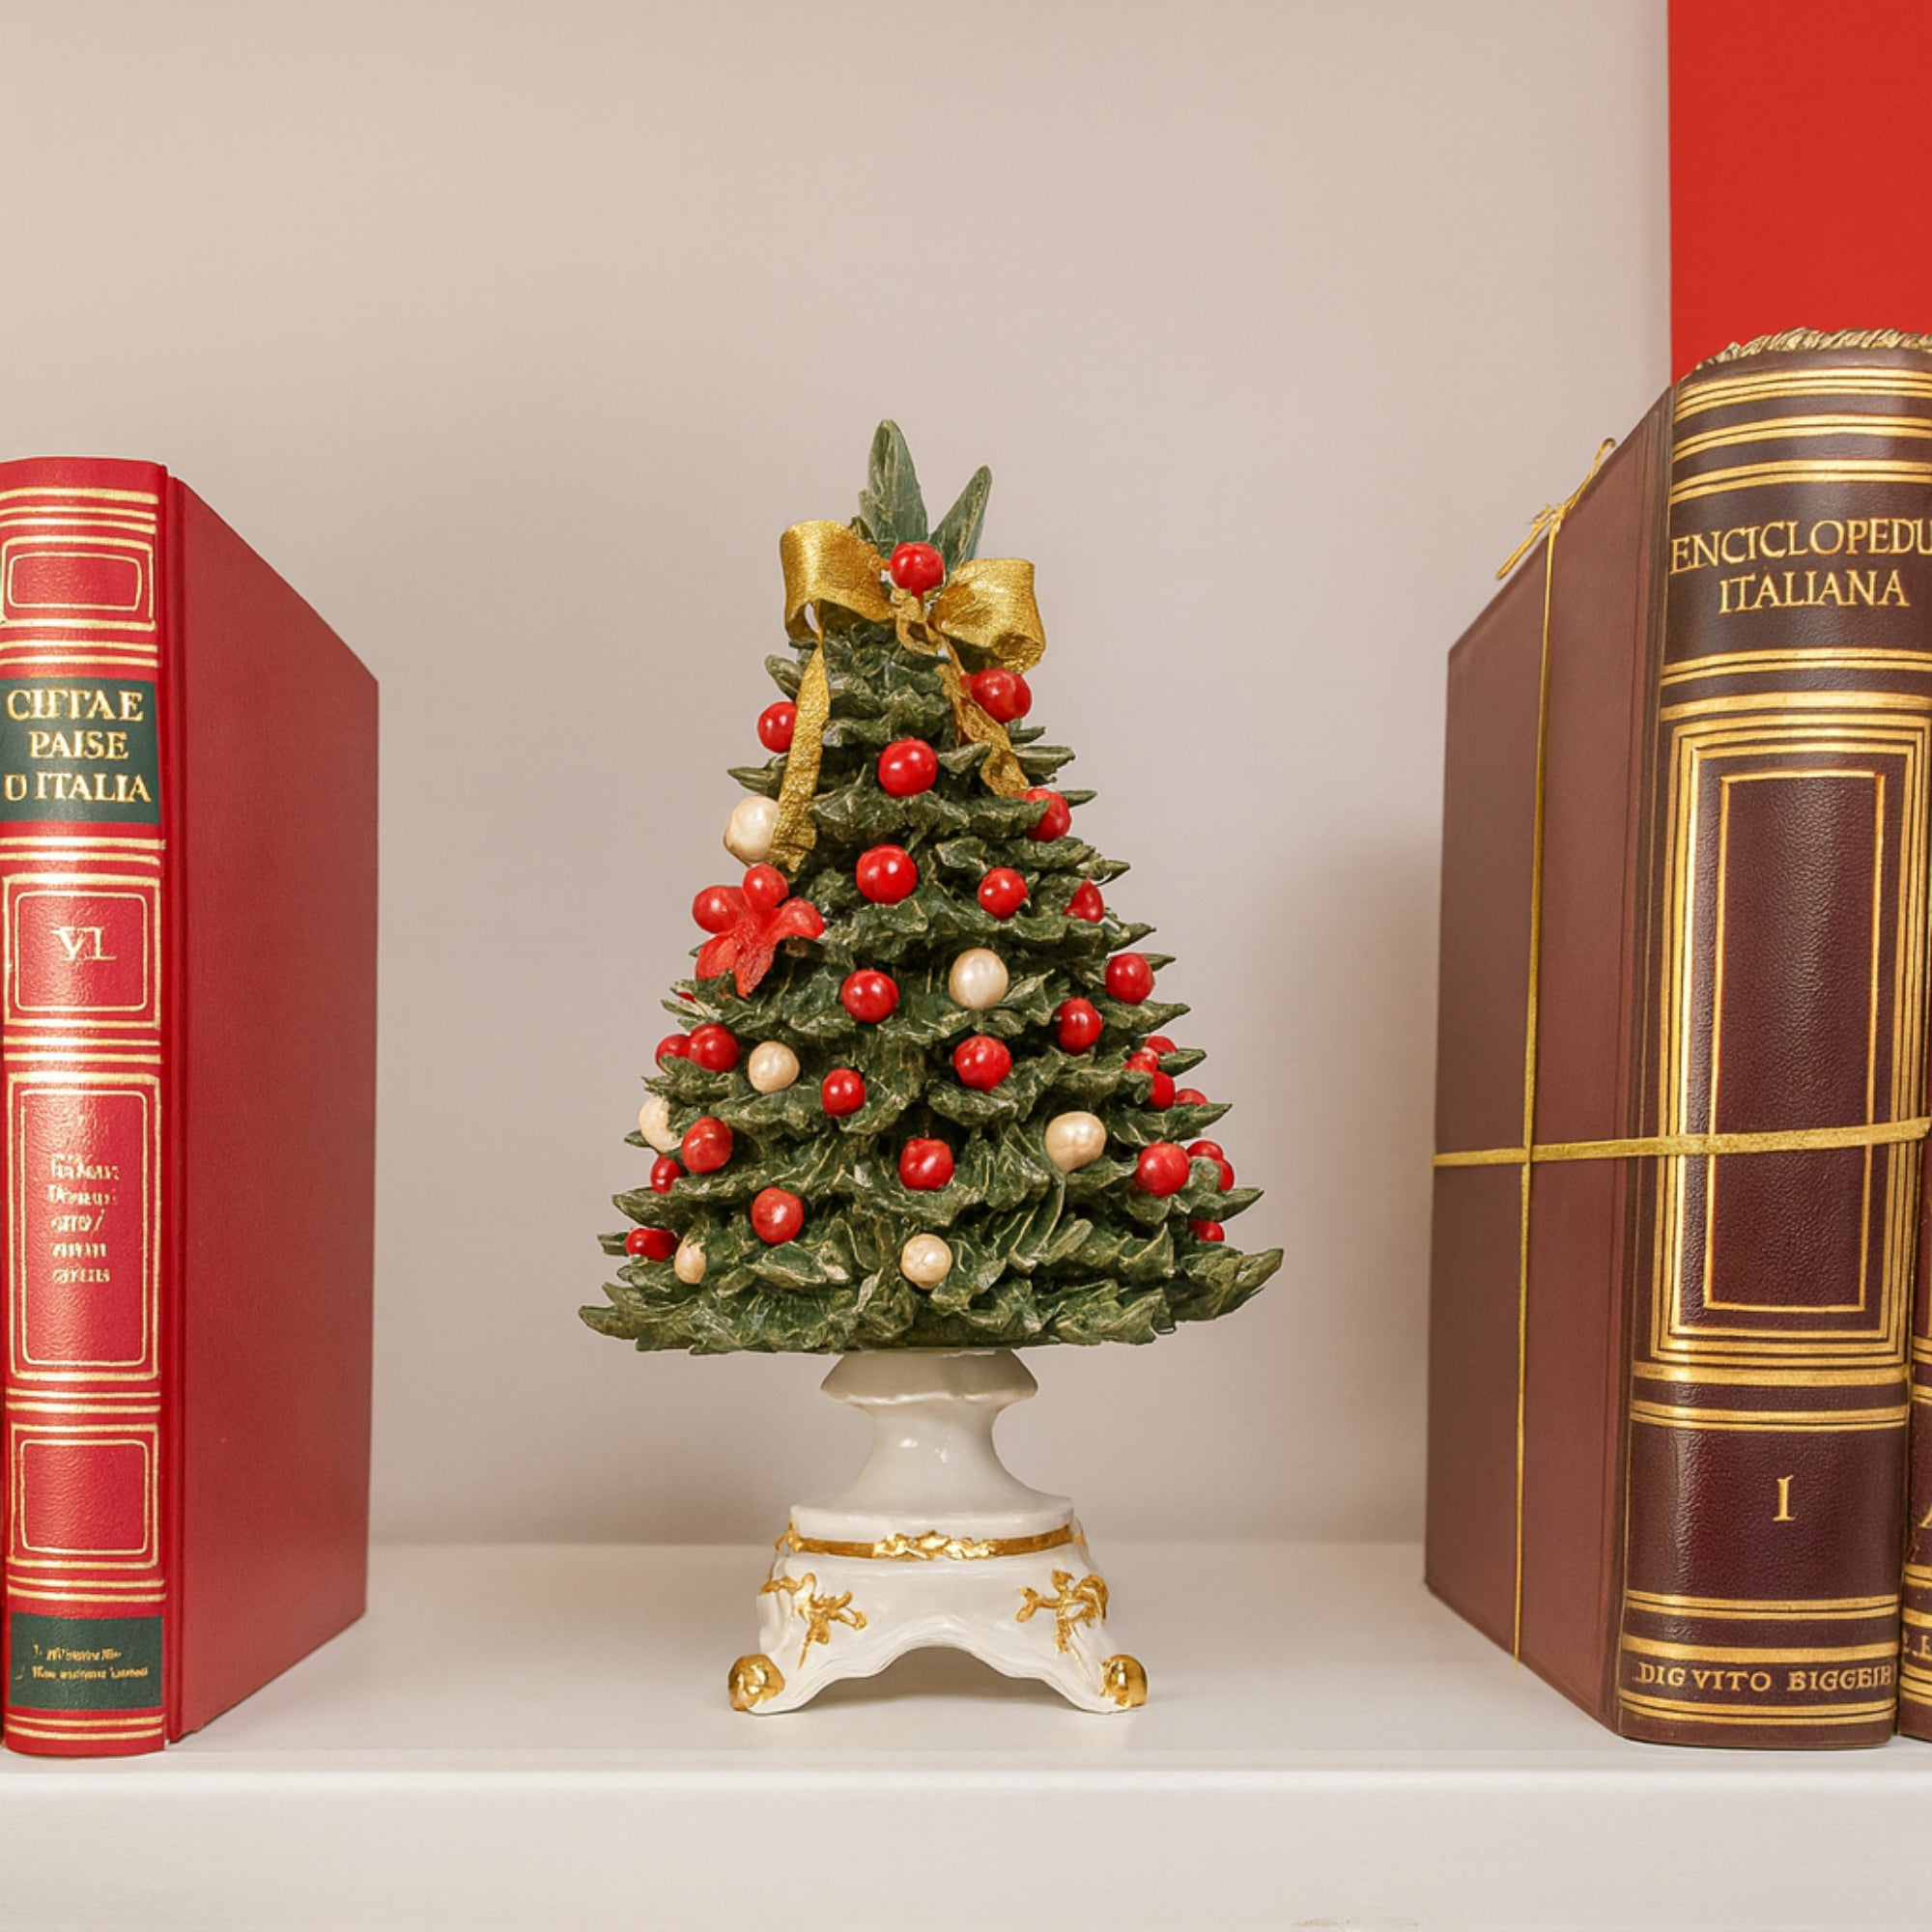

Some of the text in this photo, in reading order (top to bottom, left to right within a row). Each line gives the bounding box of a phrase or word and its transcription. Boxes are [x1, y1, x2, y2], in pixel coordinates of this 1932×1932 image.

[1719, 569, 1911, 615] ITALIANA
[35, 771, 152, 804] ITALIA
[1691, 1669, 1772, 1691] VITO
